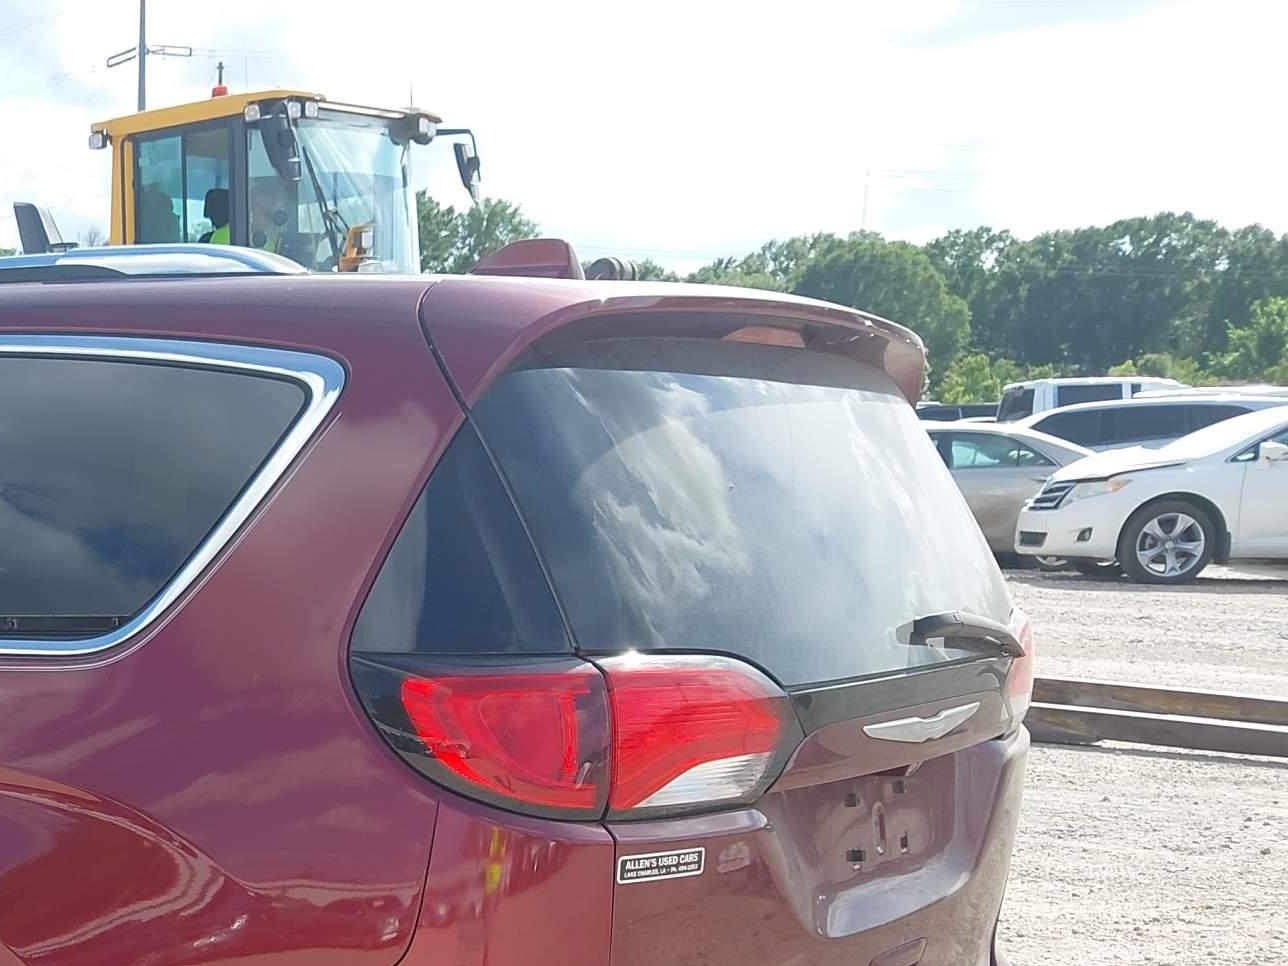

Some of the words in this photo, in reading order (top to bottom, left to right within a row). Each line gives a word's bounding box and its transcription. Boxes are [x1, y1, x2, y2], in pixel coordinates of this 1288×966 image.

[626, 858, 656, 870] ALLEN'S
[658, 856, 678, 866] USED
[680, 853, 698, 864] CARS
